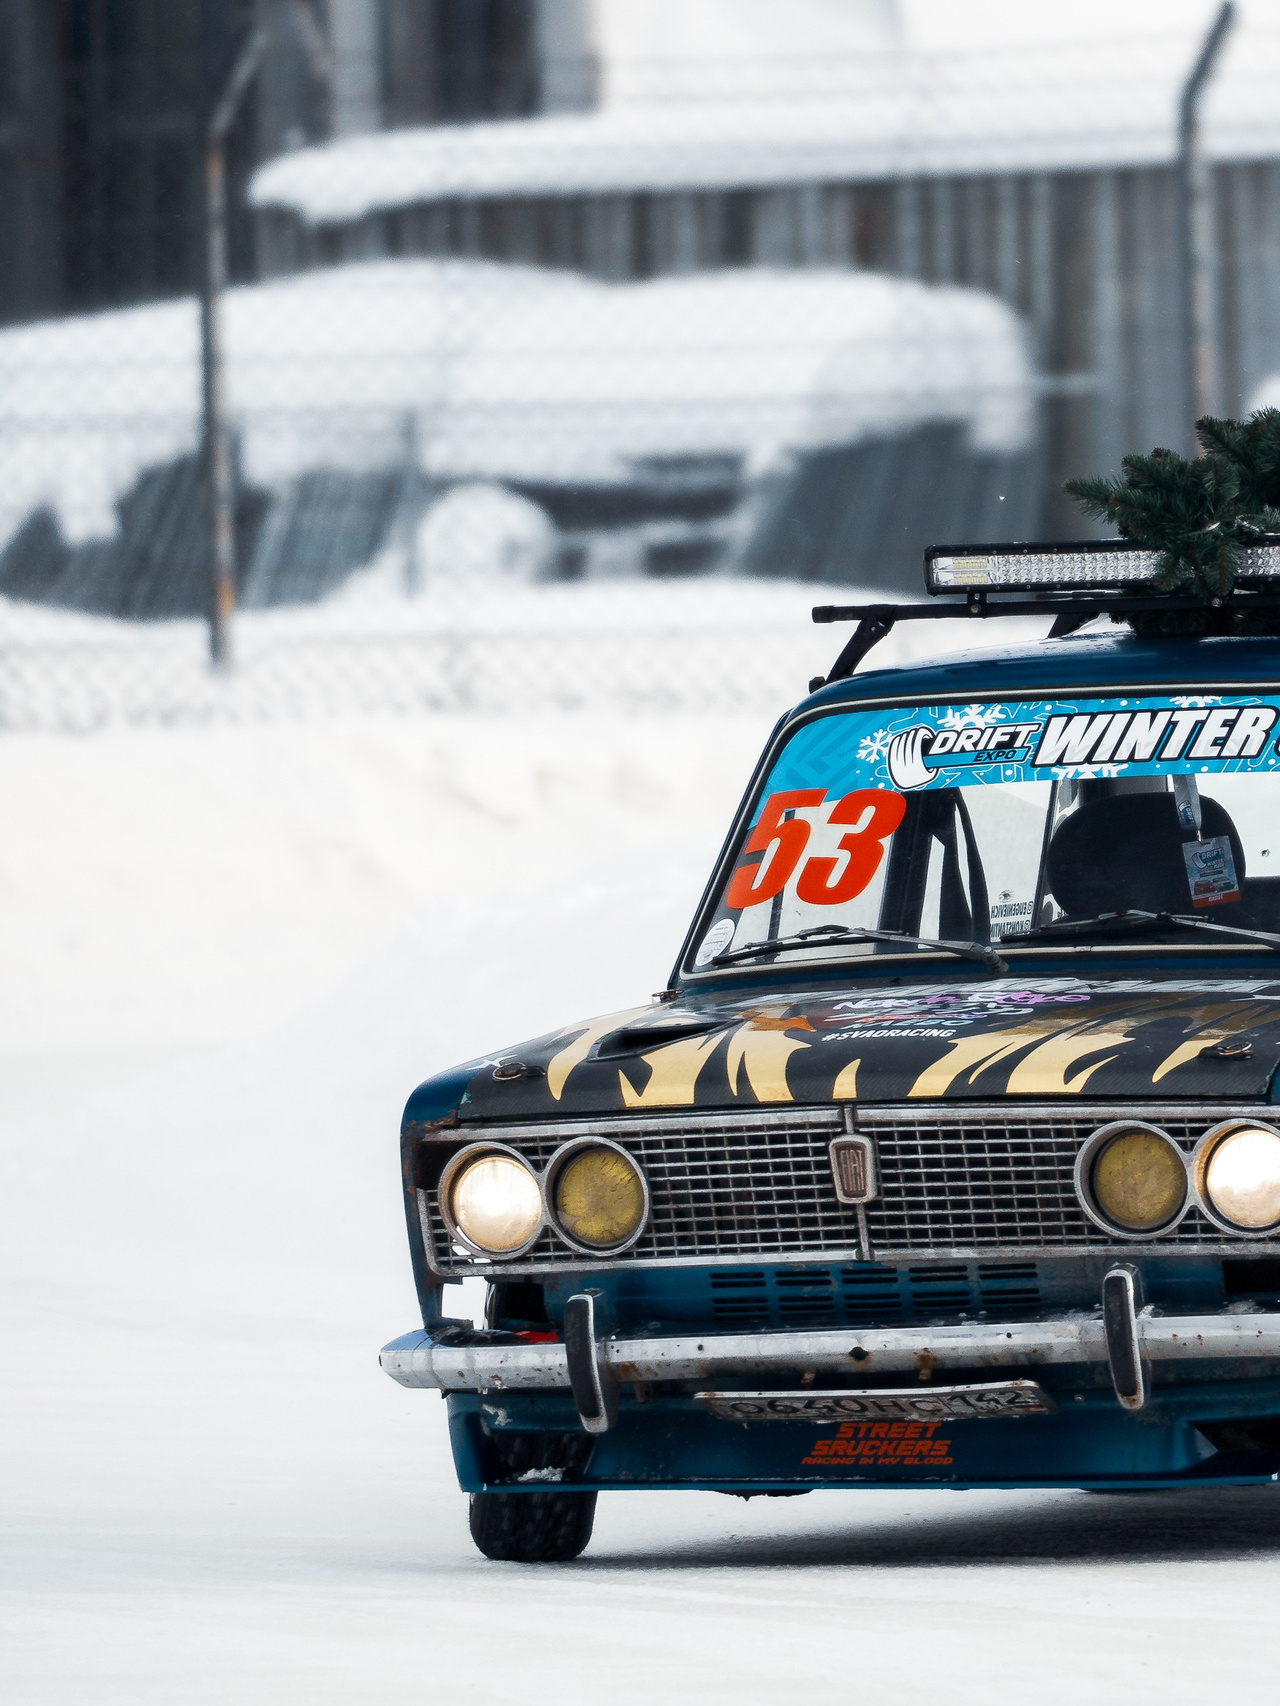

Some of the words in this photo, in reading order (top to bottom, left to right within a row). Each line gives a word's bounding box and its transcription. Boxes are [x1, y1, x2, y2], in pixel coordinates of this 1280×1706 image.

[929, 723, 1041, 754] DRIFT
[1033, 705, 1279, 766] WINTER
[973, 749, 1017, 762] EXPO
[726, 788, 907, 909] 53
[840, 1148, 865, 1192] FIAT
[835, 1422, 943, 1438] STREET
[810, 1440, 952, 1456] SRUCKERS
[801, 1457, 855, 1465] RACING
[858, 1457, 875, 1465] IN
[877, 1457, 900, 1465] MY
[903, 1457, 954, 1465] BLOOD
